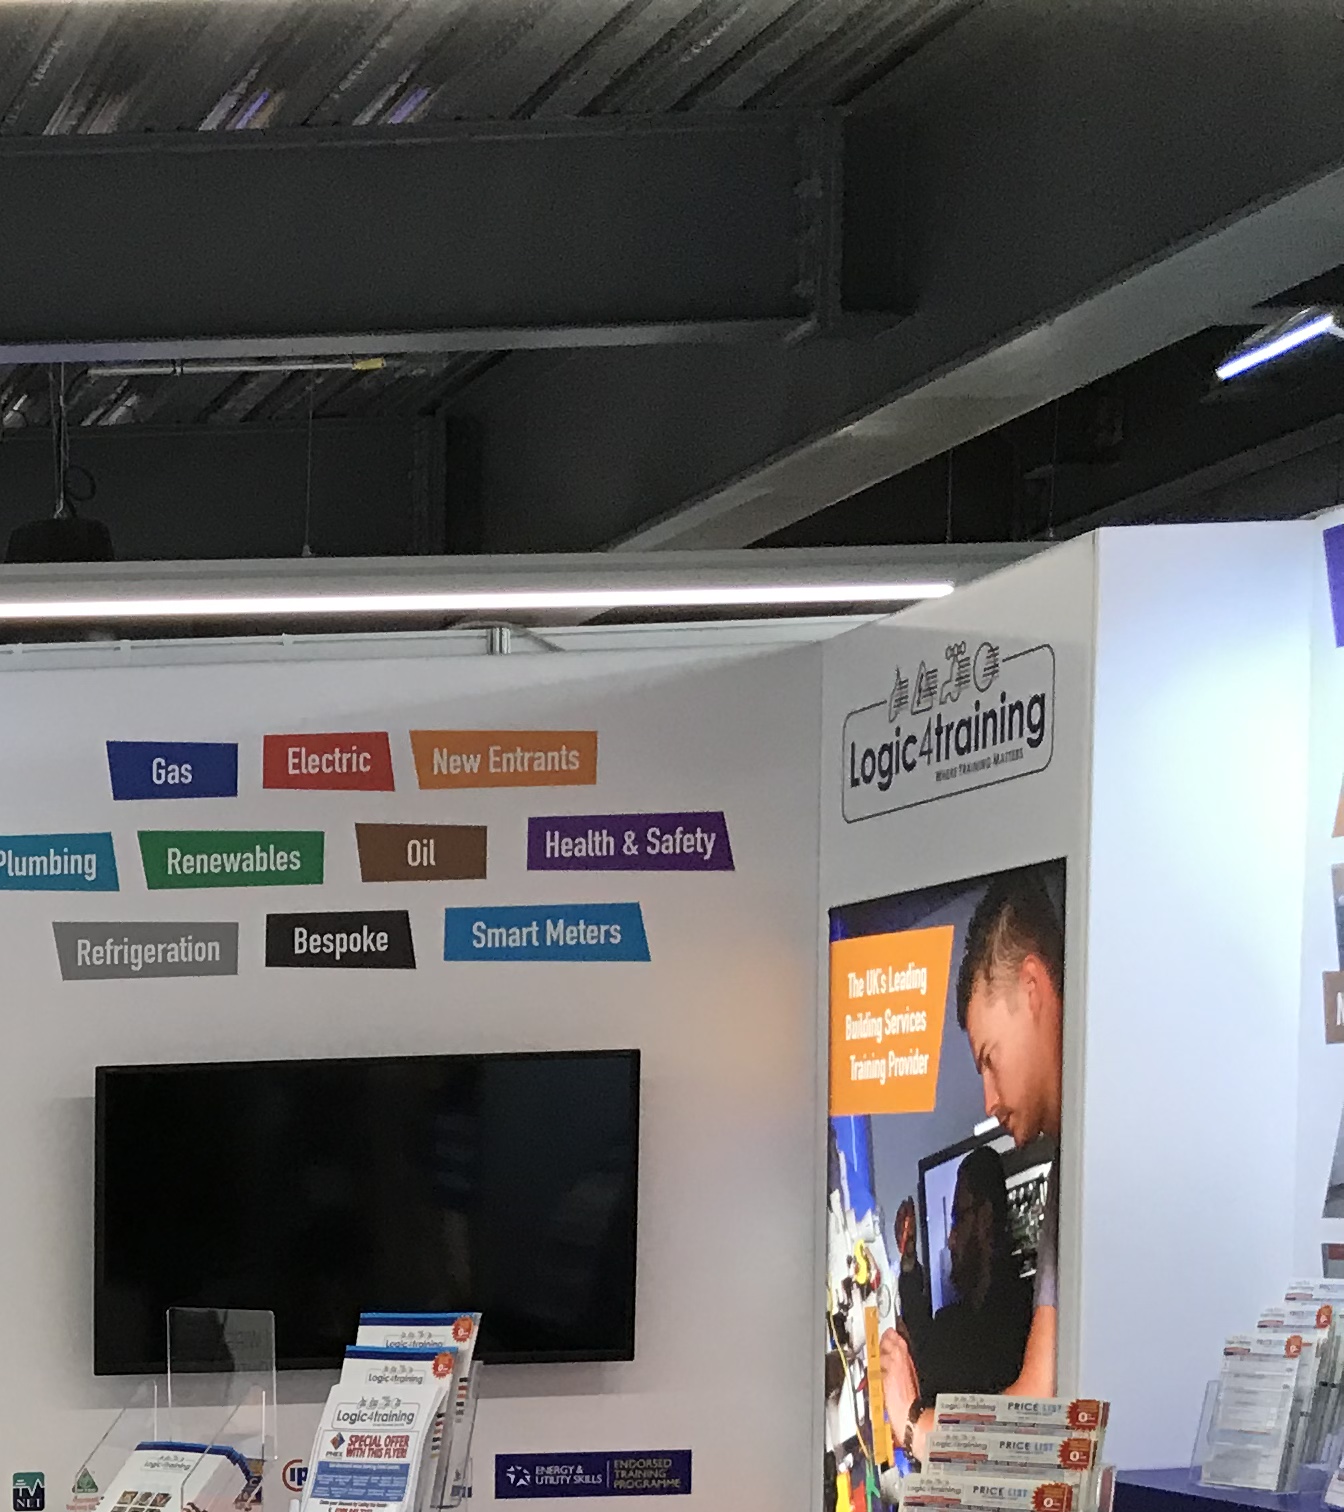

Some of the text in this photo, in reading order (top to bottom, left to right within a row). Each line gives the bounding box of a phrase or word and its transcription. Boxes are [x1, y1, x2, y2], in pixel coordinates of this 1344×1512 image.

[850, 691, 1045, 791] Logic4training
[152, 757, 192, 785] Gas
[287, 745, 371, 775] Electric
[432, 744, 580, 775] New Entrants
[407, 839, 436, 867] Oil
[545, 826, 716, 861] Health & Safety
[167, 844, 301, 875] Renewables
[293, 925, 388, 960] Bespoke
[472, 920, 622, 950] Smart Meters
[76, 935, 220, 971] Refrigeration
[848, 961, 928, 999] The UK's Leading
[845, 1006, 927, 1044] Building Services
[850, 1048, 929, 1085] Training Provider
[336, 1410, 414, 1425] Logic4training
[1007, 1402, 1038, 1412] PRICE
[348, 1435, 410, 1448] SPECIAL OFFER
[999, 1441, 1030, 1450] PRICE
[535, 1465, 575, 1475] ENERGY
[535, 1473, 603, 1485] UTILITY SKILLS
[614, 1478, 681, 1489] PROGRAMME
[972, 1486, 1004, 1496] PRICE
